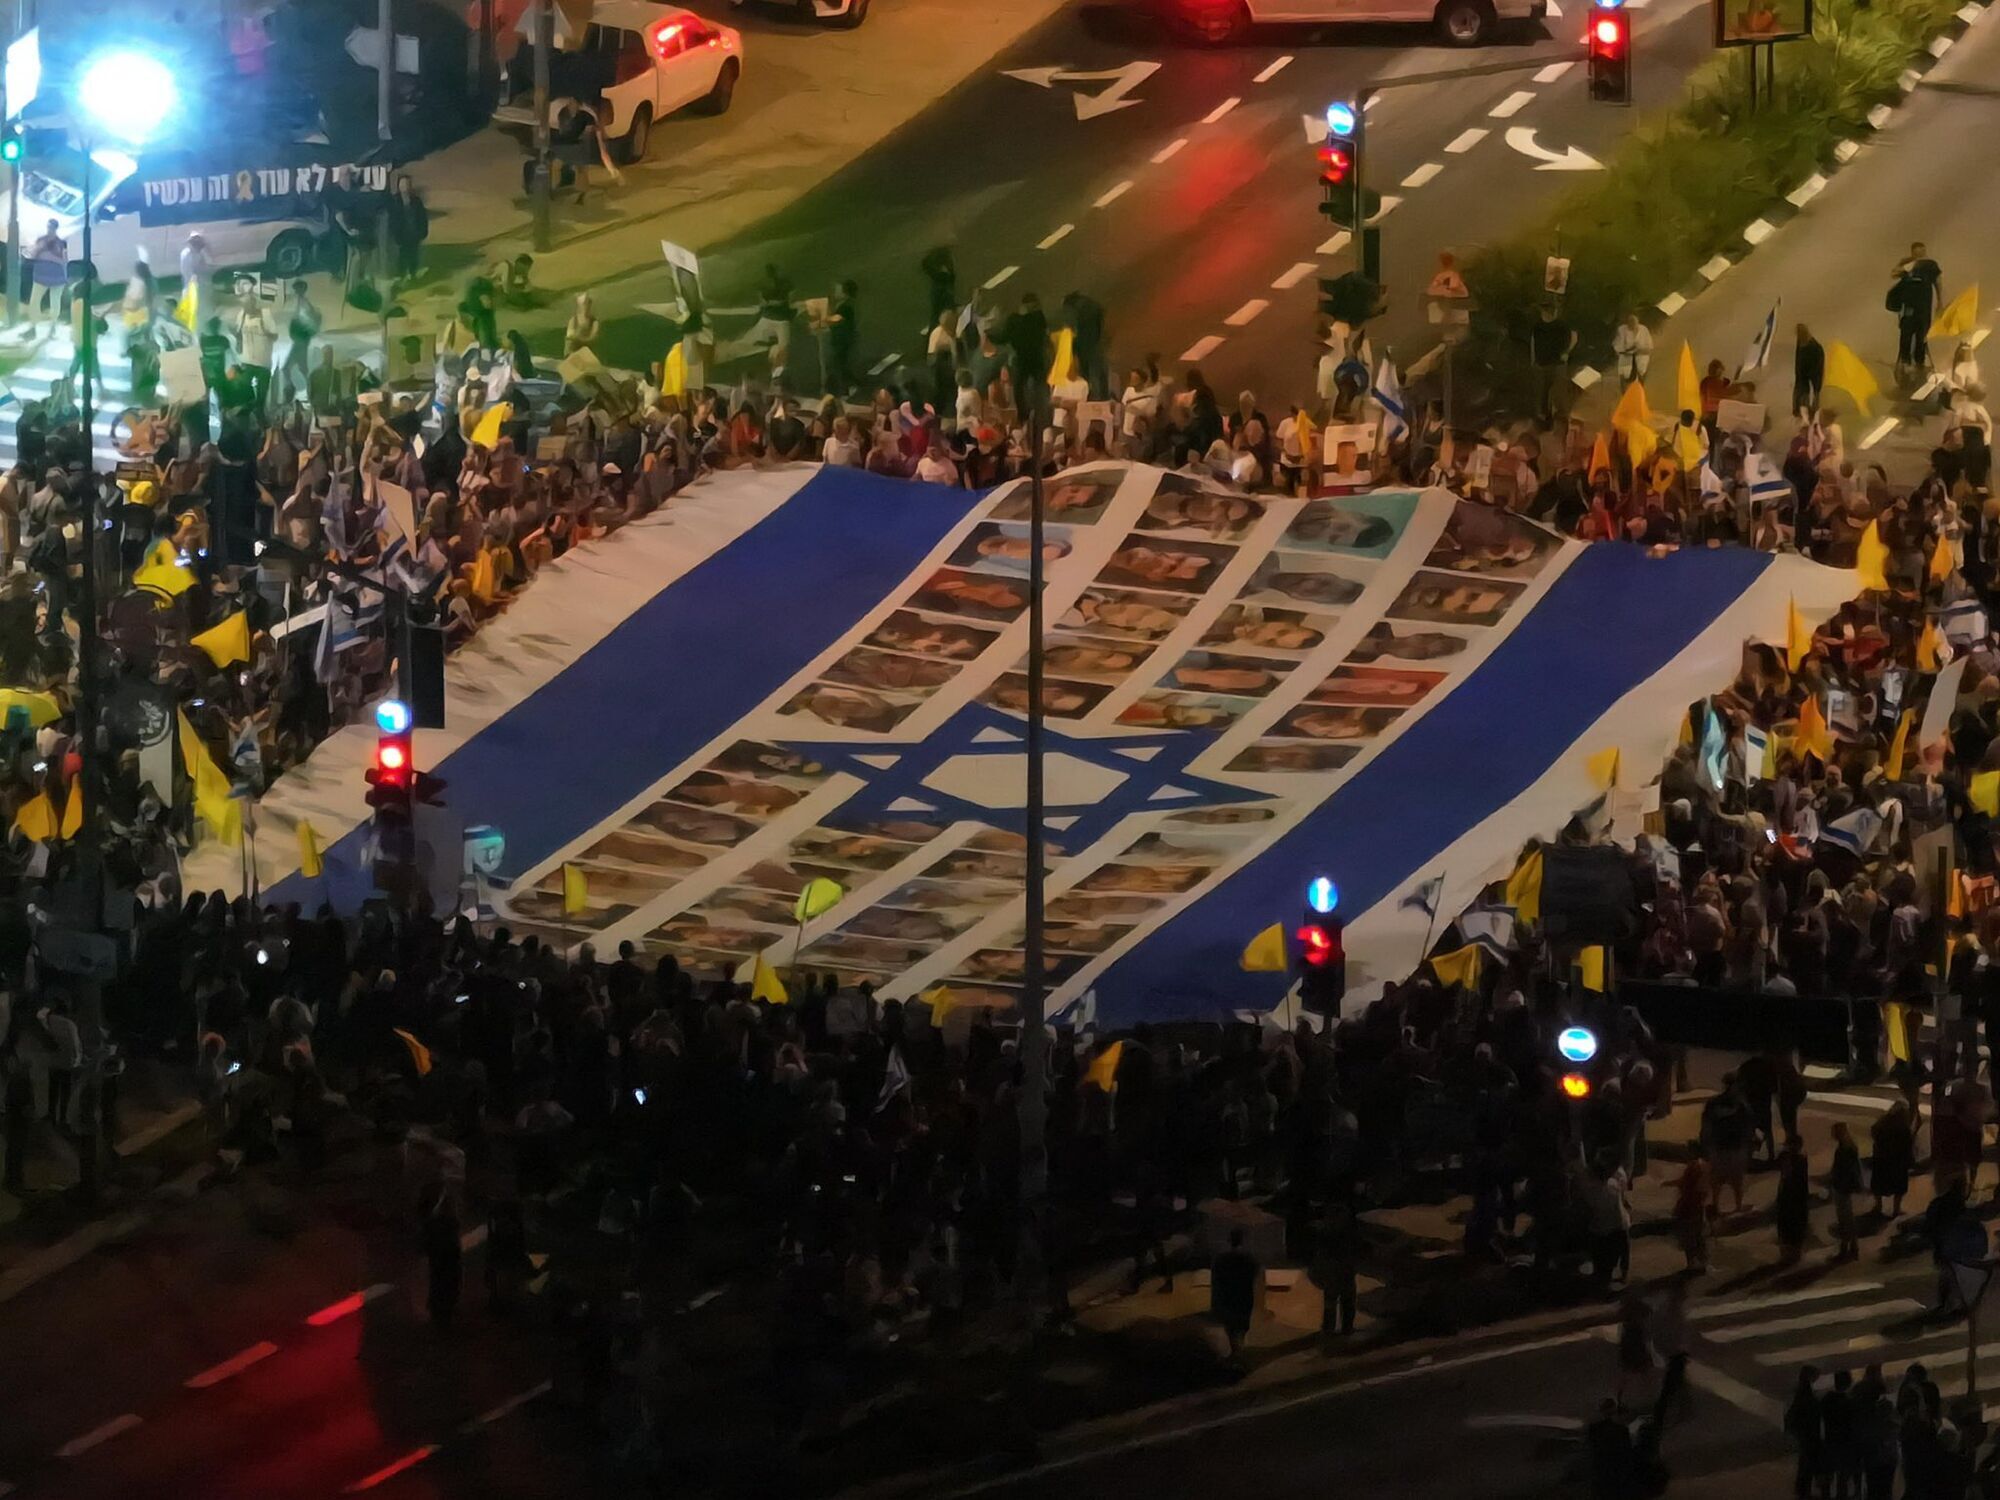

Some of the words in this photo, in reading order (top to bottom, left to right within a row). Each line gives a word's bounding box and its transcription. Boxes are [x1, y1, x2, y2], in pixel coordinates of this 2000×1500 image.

[143, 176, 203, 207] עכשיו
[207, 173, 230, 201] זה
[257, 167, 290, 197] עוד
[295, 162, 327, 195] לא
